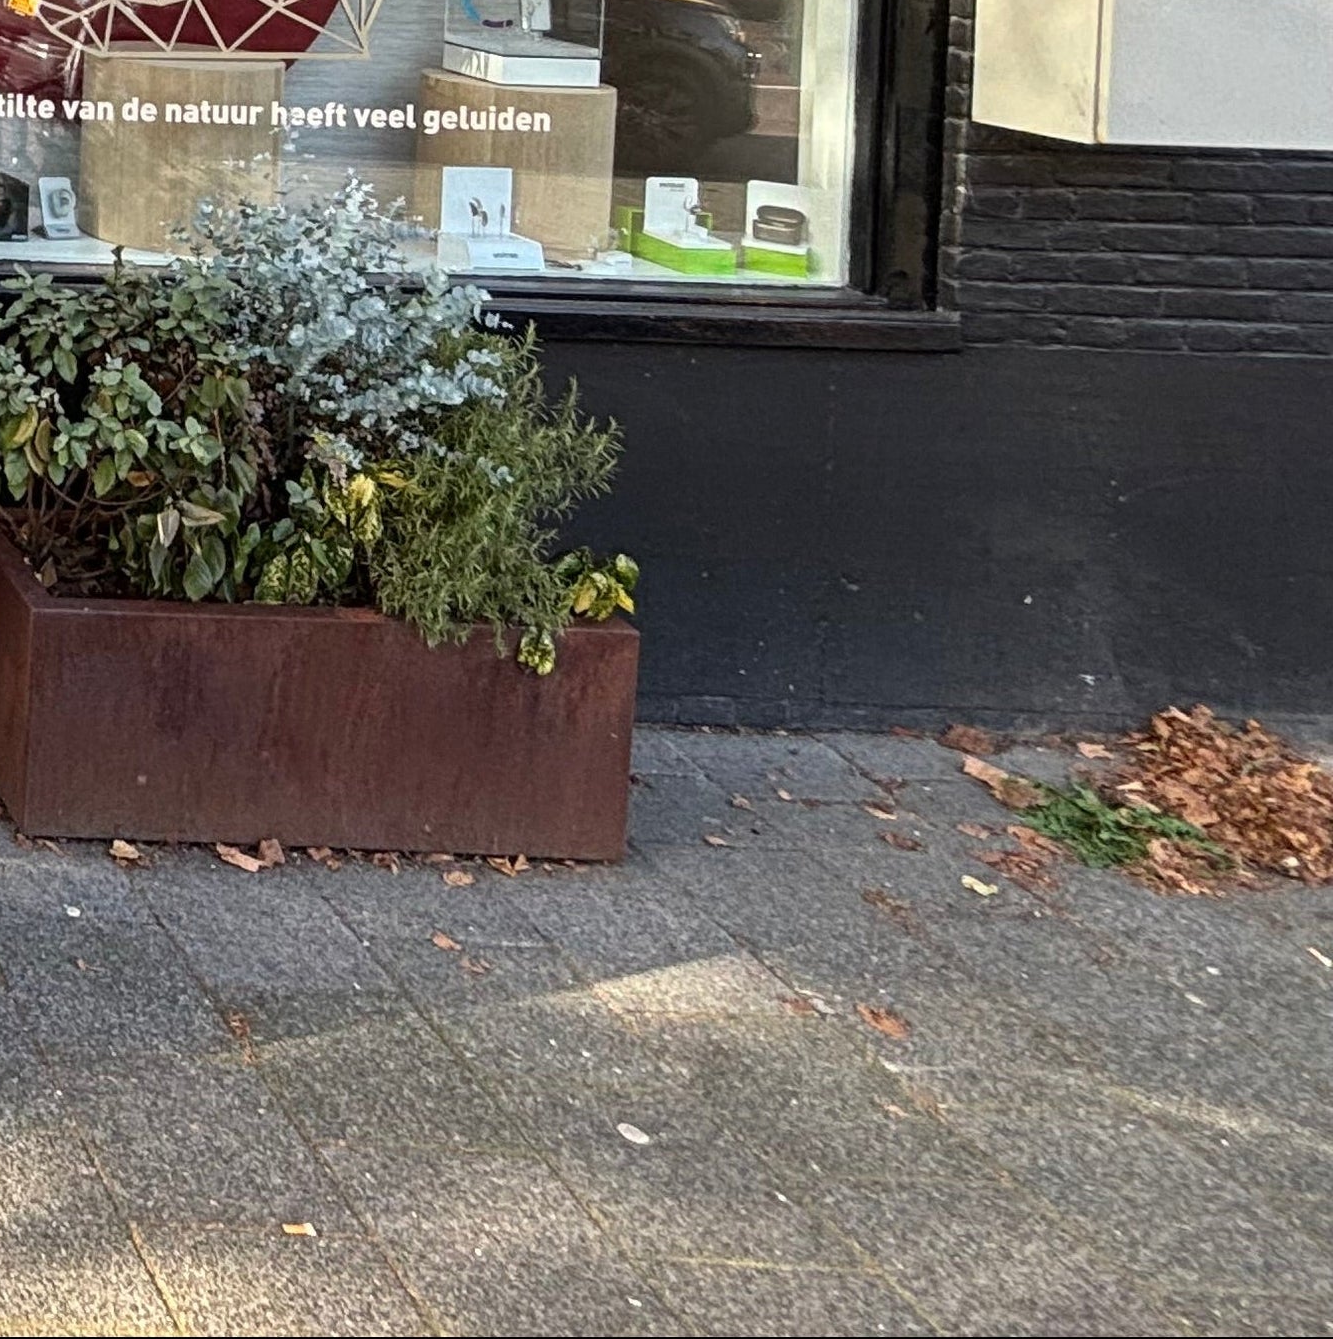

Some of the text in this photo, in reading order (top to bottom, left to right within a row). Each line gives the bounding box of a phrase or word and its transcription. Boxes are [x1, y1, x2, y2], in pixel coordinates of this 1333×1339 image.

[62, 99, 114, 121] van
[122, 97, 158, 123] de
[165, 100, 264, 125] natuur
[271, 101, 346, 128] heeft
[353, 104, 416, 129] veel
[423, 105, 551, 135] geluiden
